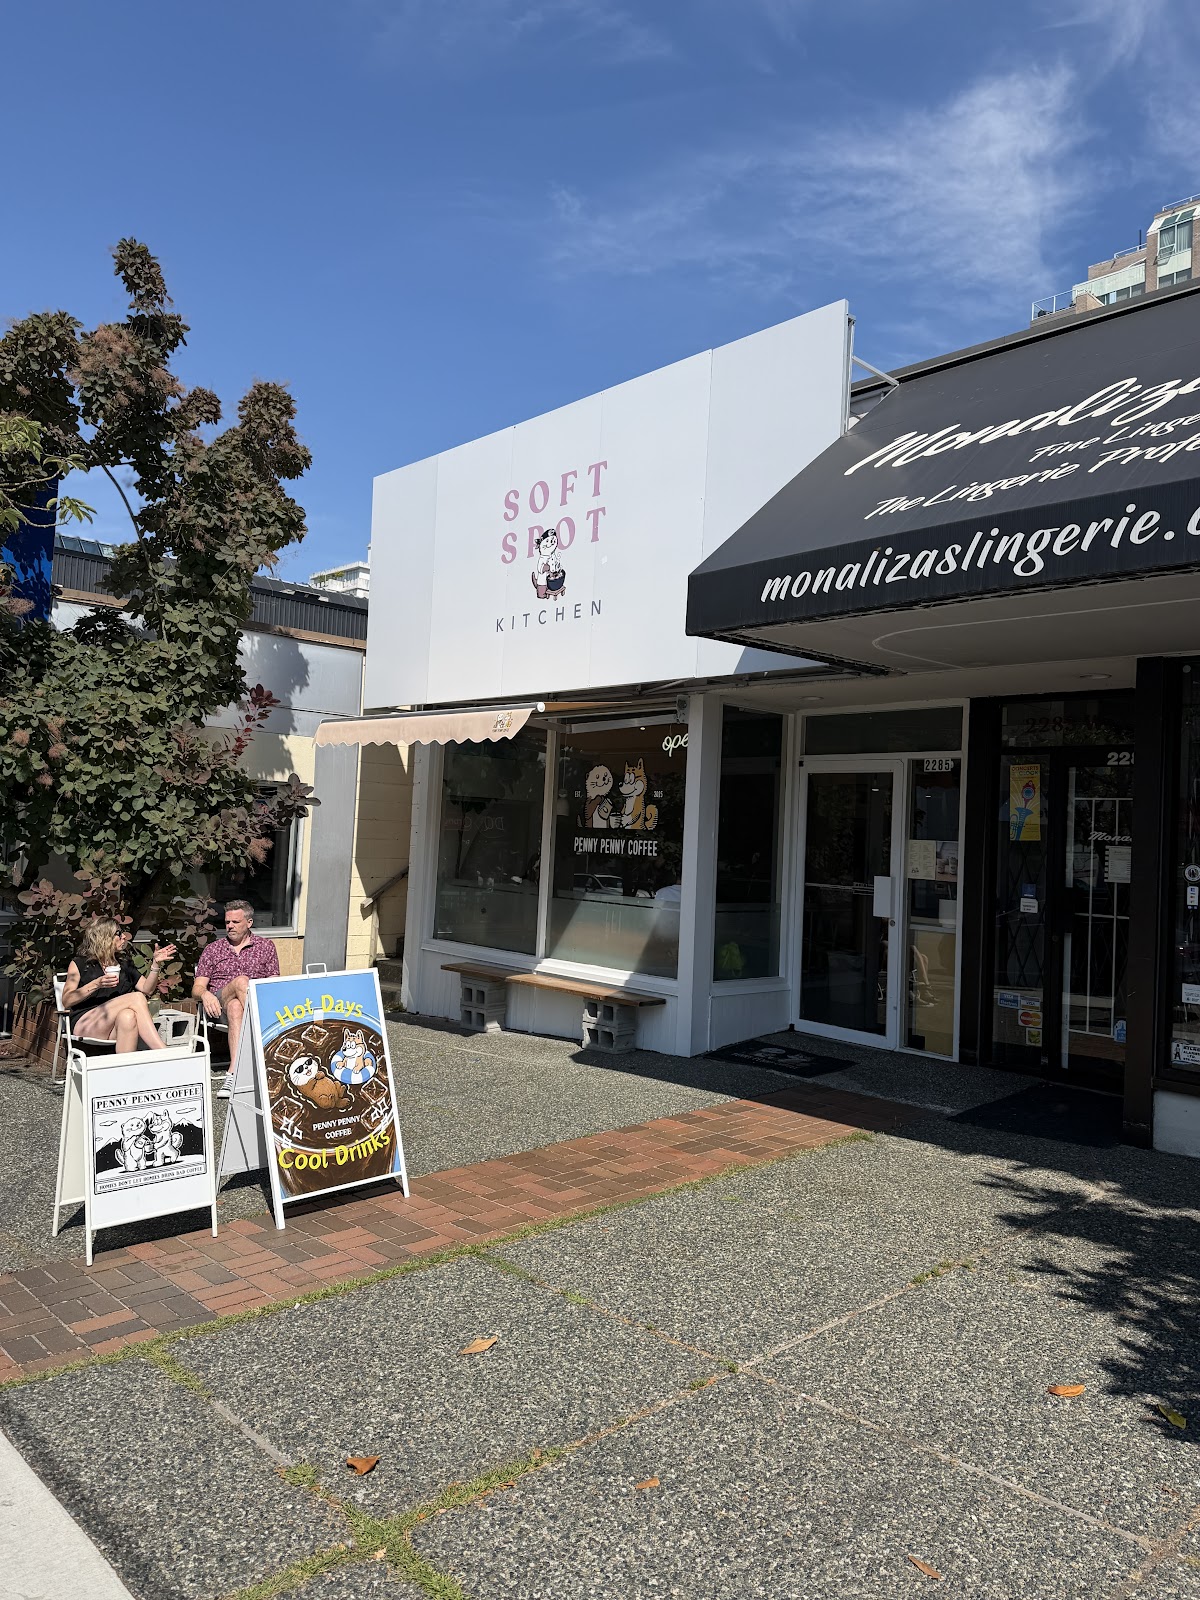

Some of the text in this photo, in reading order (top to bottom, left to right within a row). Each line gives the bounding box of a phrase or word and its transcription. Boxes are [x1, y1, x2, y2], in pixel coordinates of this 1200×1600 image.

[1029, 437, 1101, 463] Fine
[503, 460, 607, 521] SOFT
[864, 496, 925, 519] The
[922, 462, 1081, 502] Lingerie
[501, 506, 606, 564] SPOT
[496, 599, 602, 632] KITCHEN
[925, 759, 950, 770] 2285
[573, 837, 658, 857] PENNY PENNY COFFEE
[1088, 831, 1133, 842] Mona
[275, 994, 363, 1026] Hot Days
[97, 1087, 201, 1109] PENNY PENNY COFFEE
[312, 1115, 361, 1131] PENNY PENNY
[324, 1128, 352, 1139] COFFEE
[278, 1130, 391, 1170] Cool Drinks
